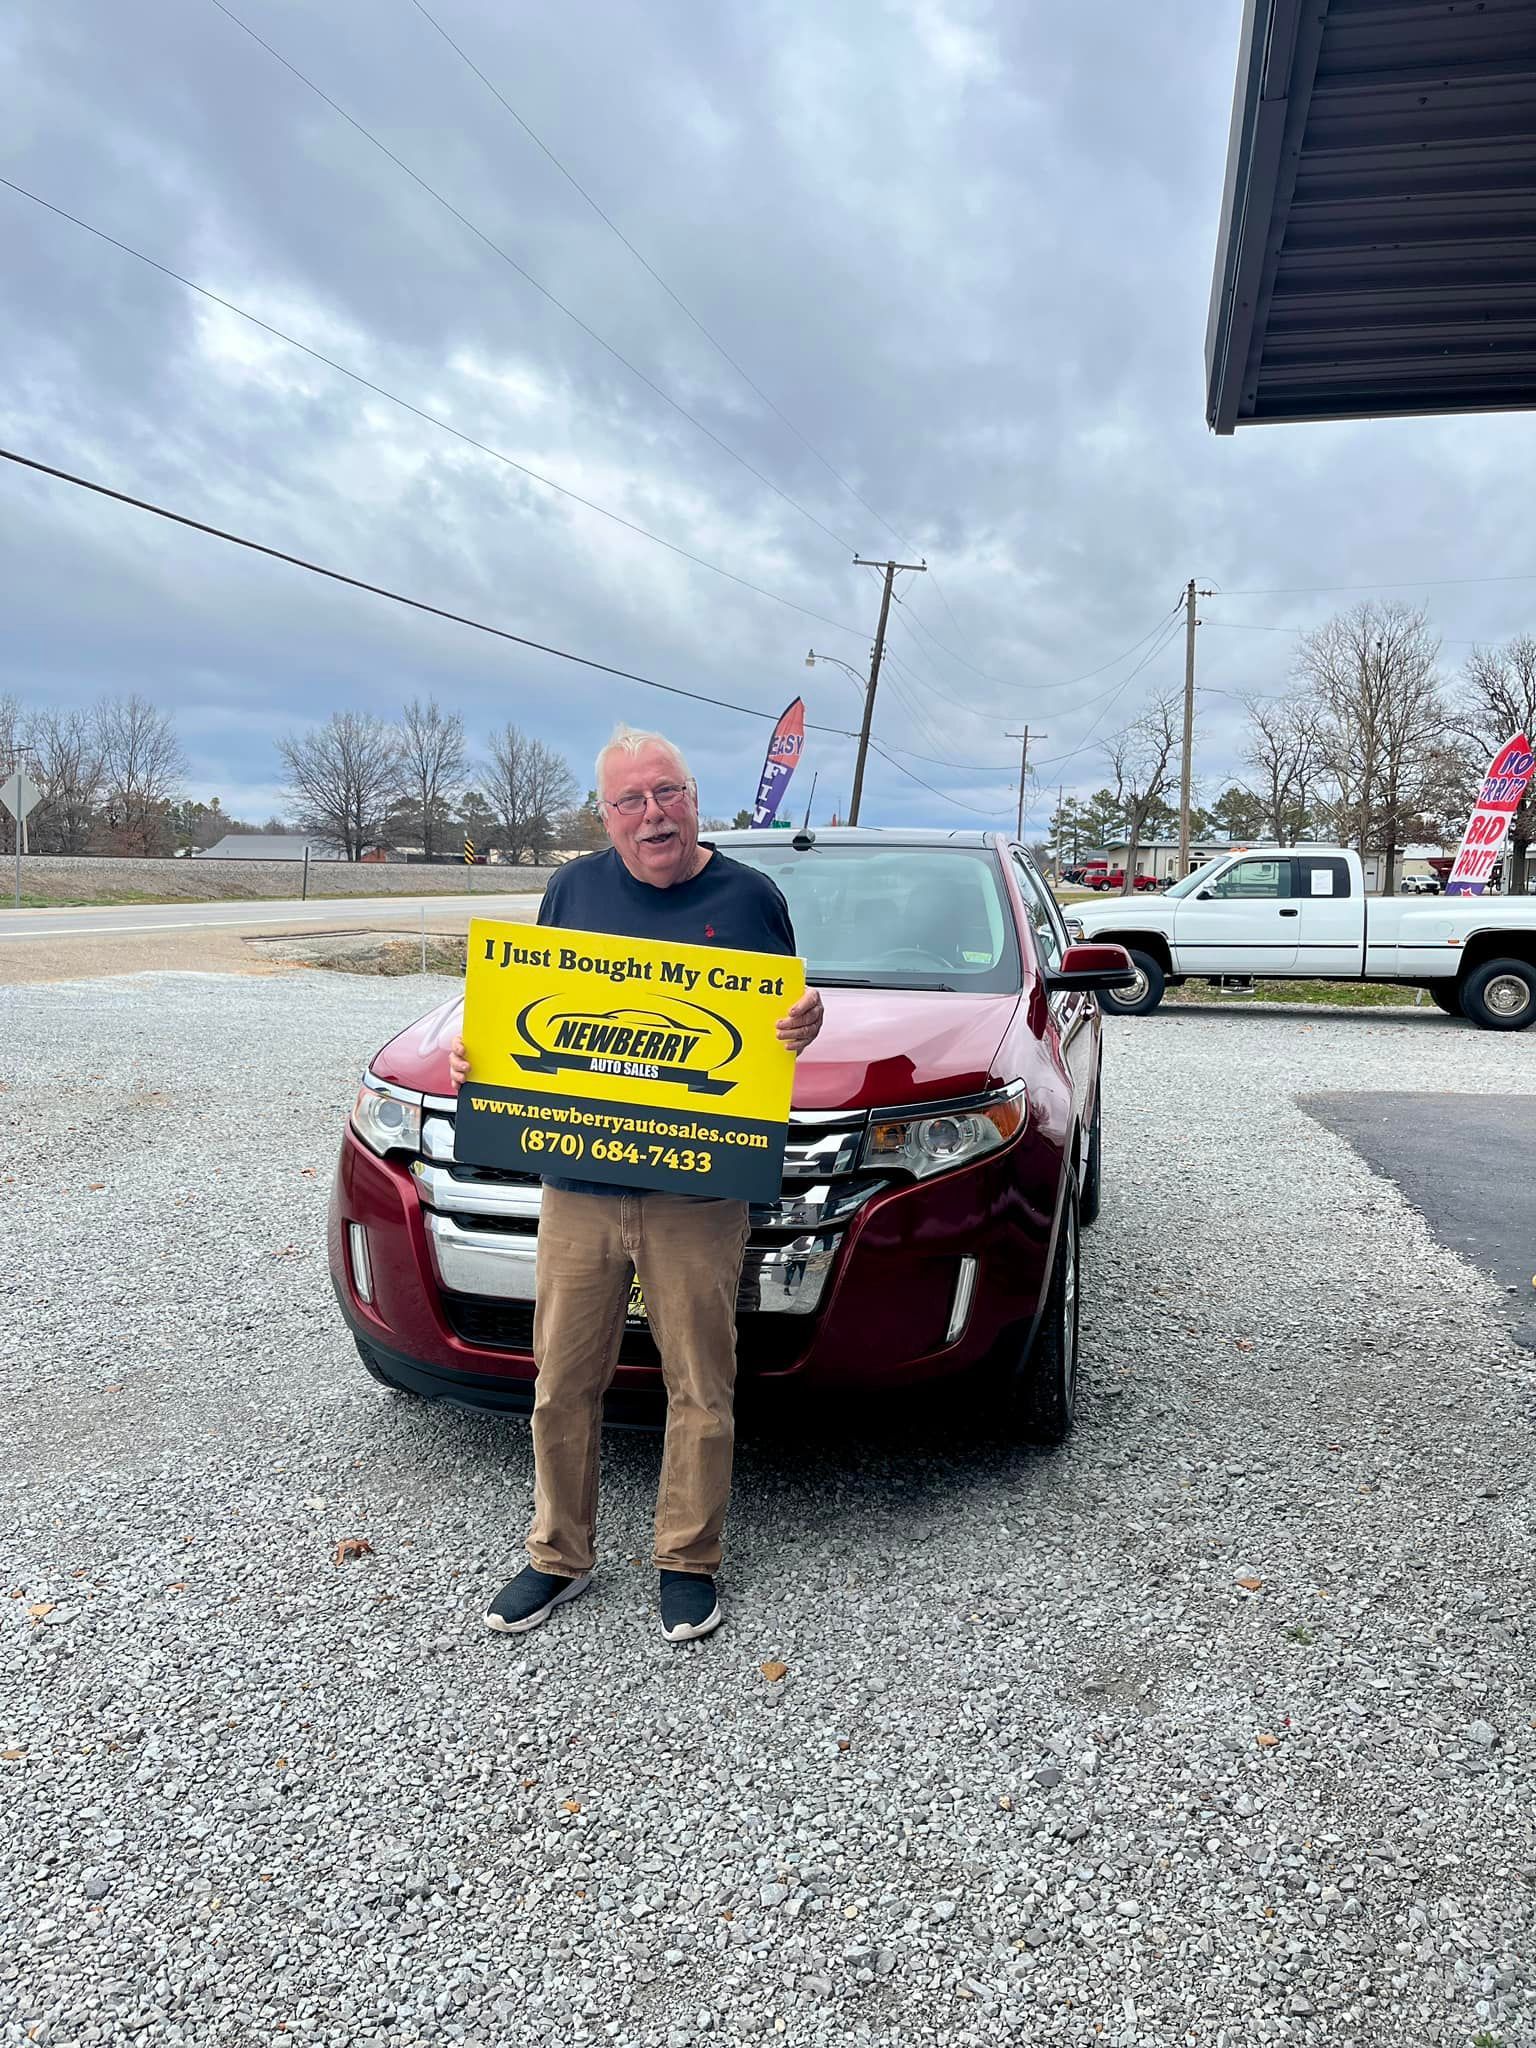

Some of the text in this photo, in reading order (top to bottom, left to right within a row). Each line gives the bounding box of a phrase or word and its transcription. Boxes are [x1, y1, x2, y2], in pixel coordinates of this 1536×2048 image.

[769, 734, 803, 756] EASY
[1500, 752, 1534, 774] NO
[1466, 816, 1505, 845] BAD
[484, 939, 784, 996] I Just Bought My Car at
[554, 1020, 700, 1064] NEWBERRY
[590, 1056, 659, 1079] AUTO SALES
[470, 1097, 769, 1149] www.newberryautosales.com
[520, 1127, 712, 1173] (870) 684-7433
